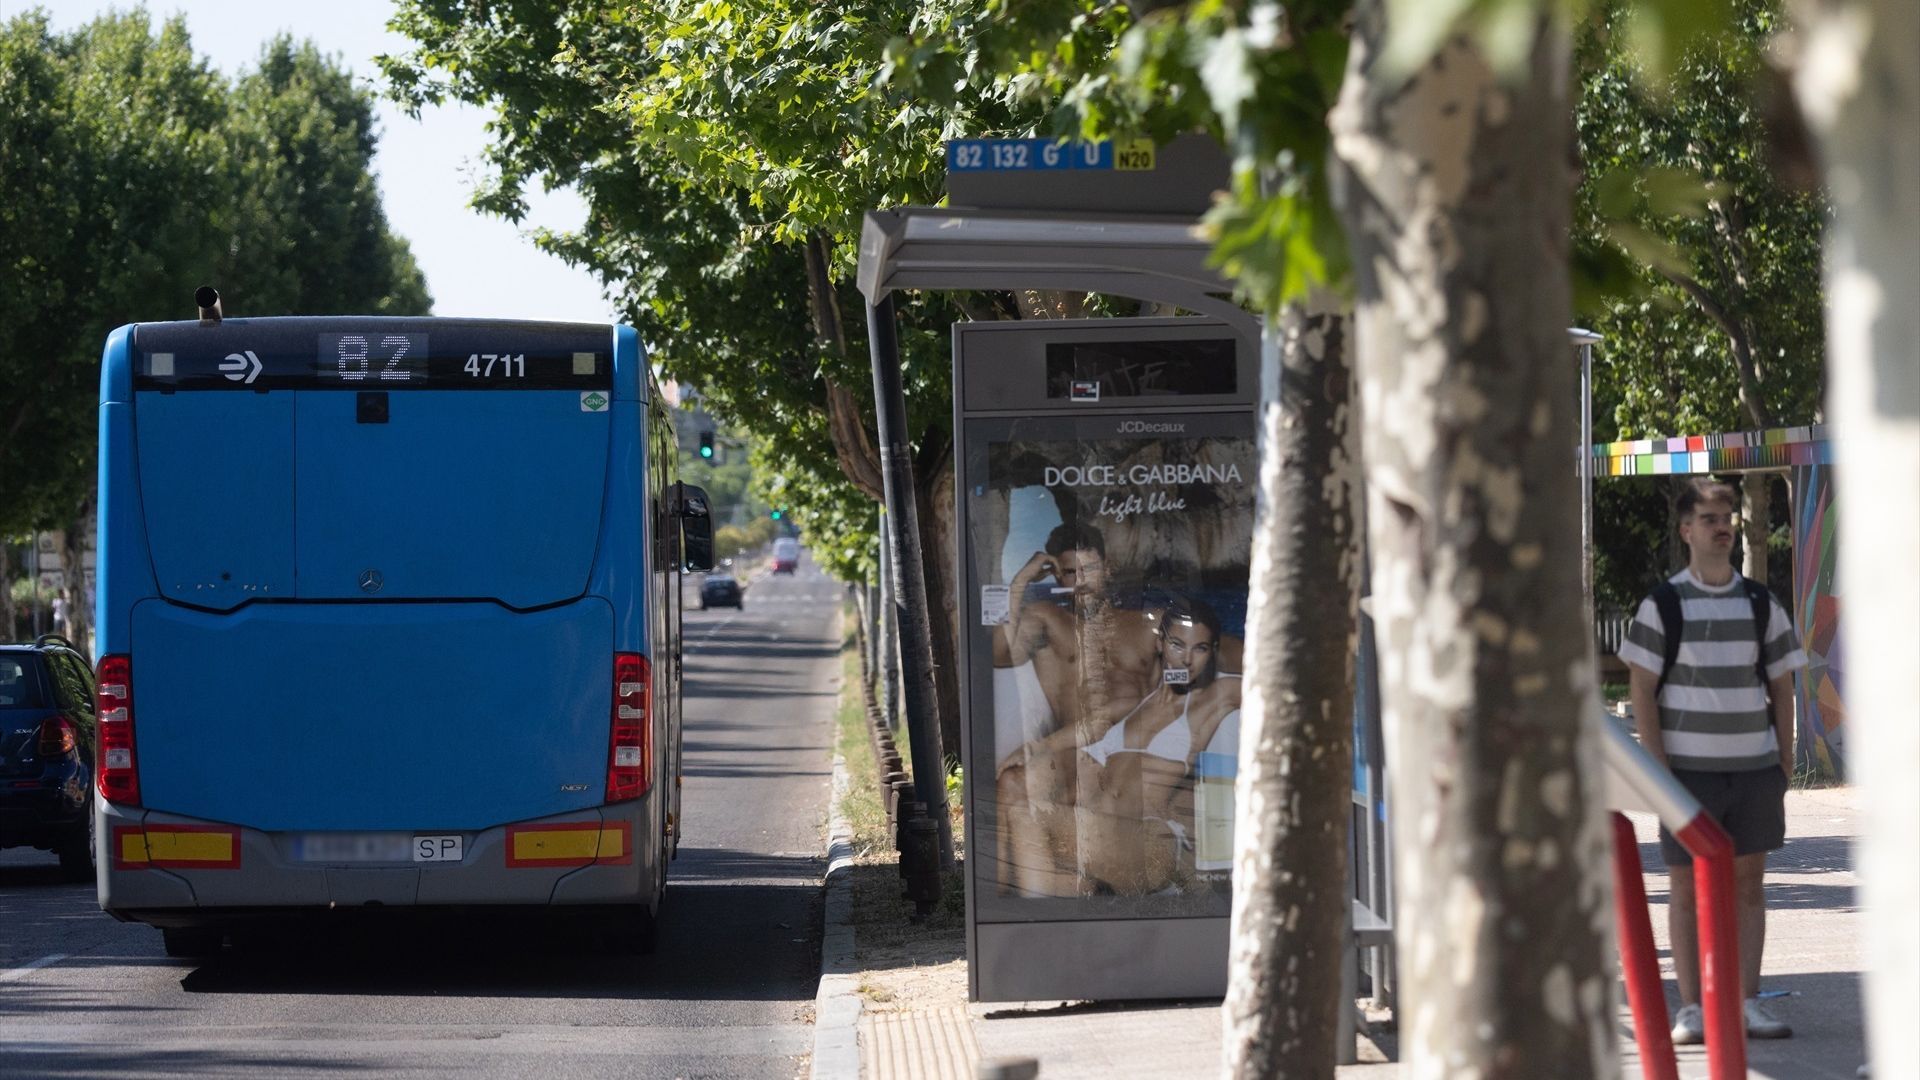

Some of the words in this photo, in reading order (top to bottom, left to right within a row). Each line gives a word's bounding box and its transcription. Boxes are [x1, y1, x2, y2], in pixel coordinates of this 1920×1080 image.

[956, 145, 982, 167] 82
[993, 144, 1028, 167] 132
[1043, 144, 1059, 166] G
[1084, 142, 1099, 165] U
[1118, 151, 1150, 168] N20
[337, 335, 411, 380] 82
[463, 354, 525, 377] 4711
[1116, 421, 1185, 433] JCDecaux
[1045, 465, 1115, 487] DOLCE
[1118, 474, 1127, 484] &
[1129, 463, 1242, 485] GABBANA
[1099, 494, 1143, 523] light
[1149, 491, 1186, 513] blue
[419, 838, 456, 859] SP
